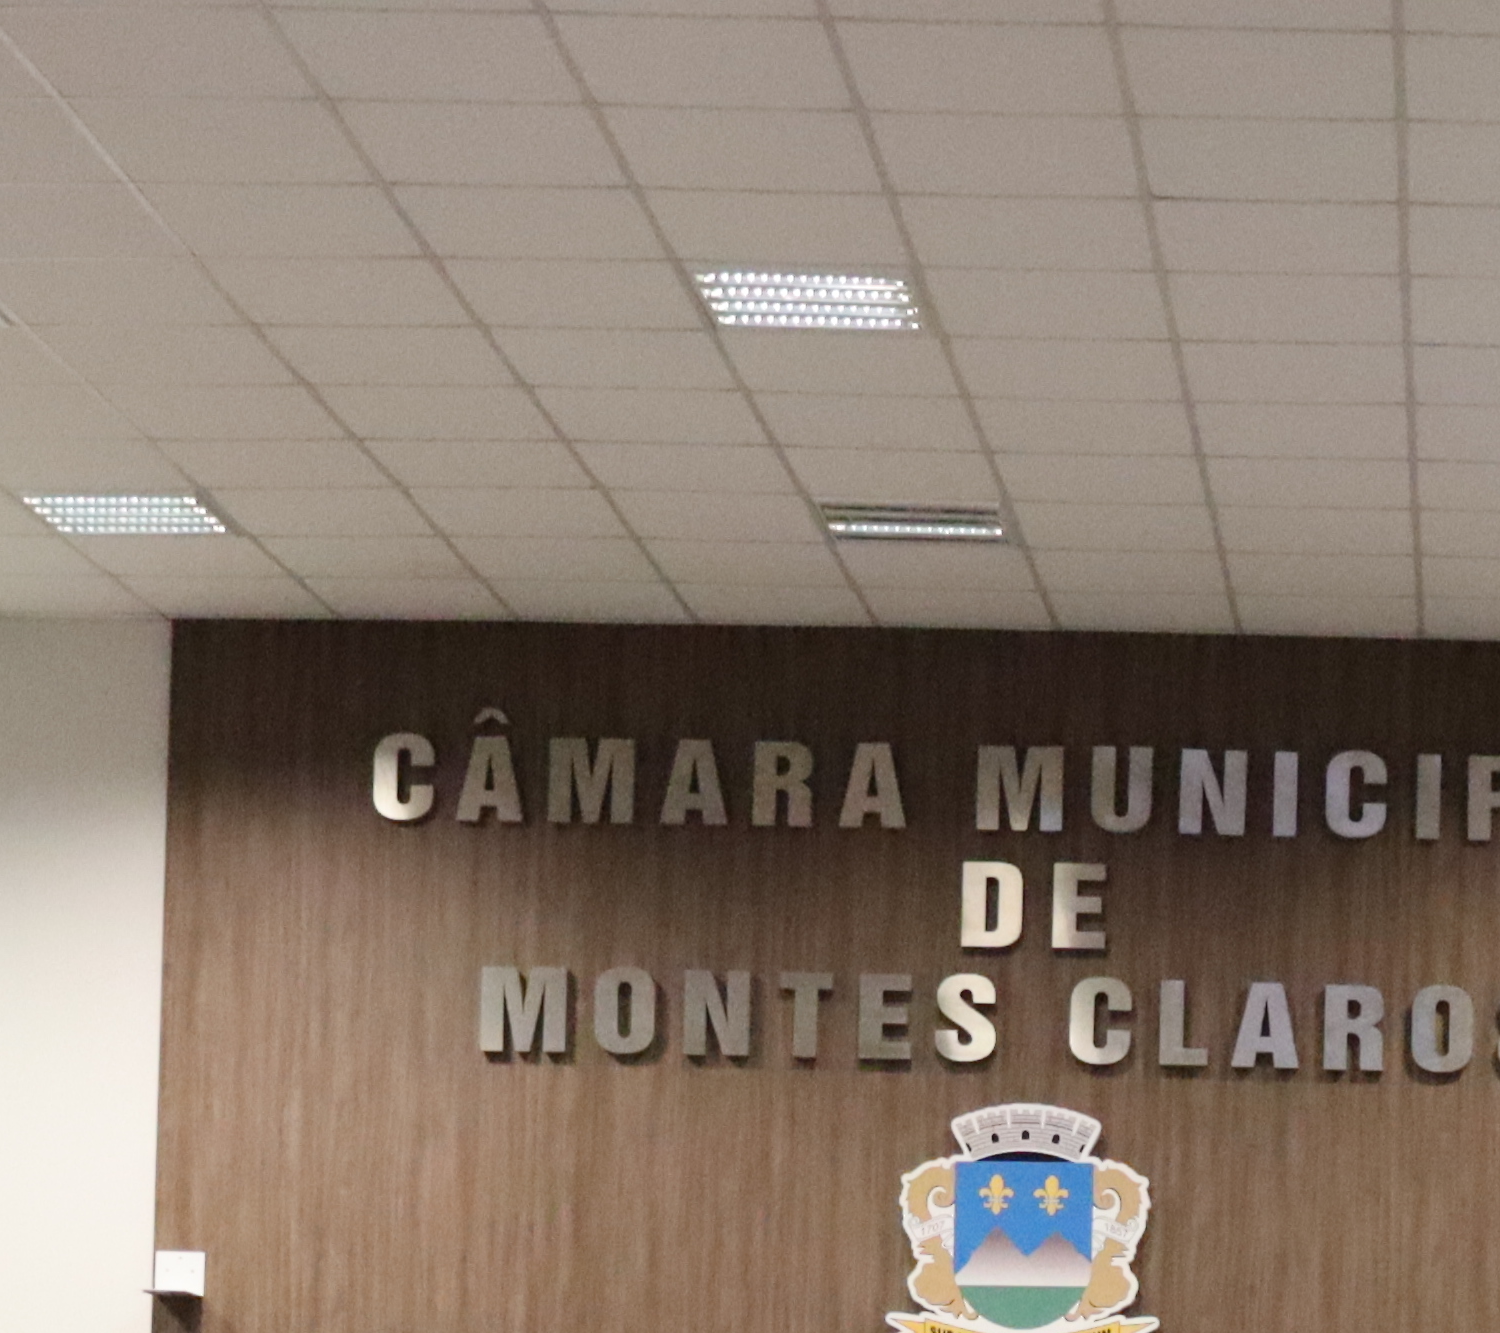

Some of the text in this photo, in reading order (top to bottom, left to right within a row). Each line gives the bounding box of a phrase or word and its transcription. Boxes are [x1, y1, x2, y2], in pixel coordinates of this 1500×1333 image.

[372, 707, 907, 829] CÂMARA
[960, 859, 1107, 950] DE
[478, 966, 998, 1063] MONTES
